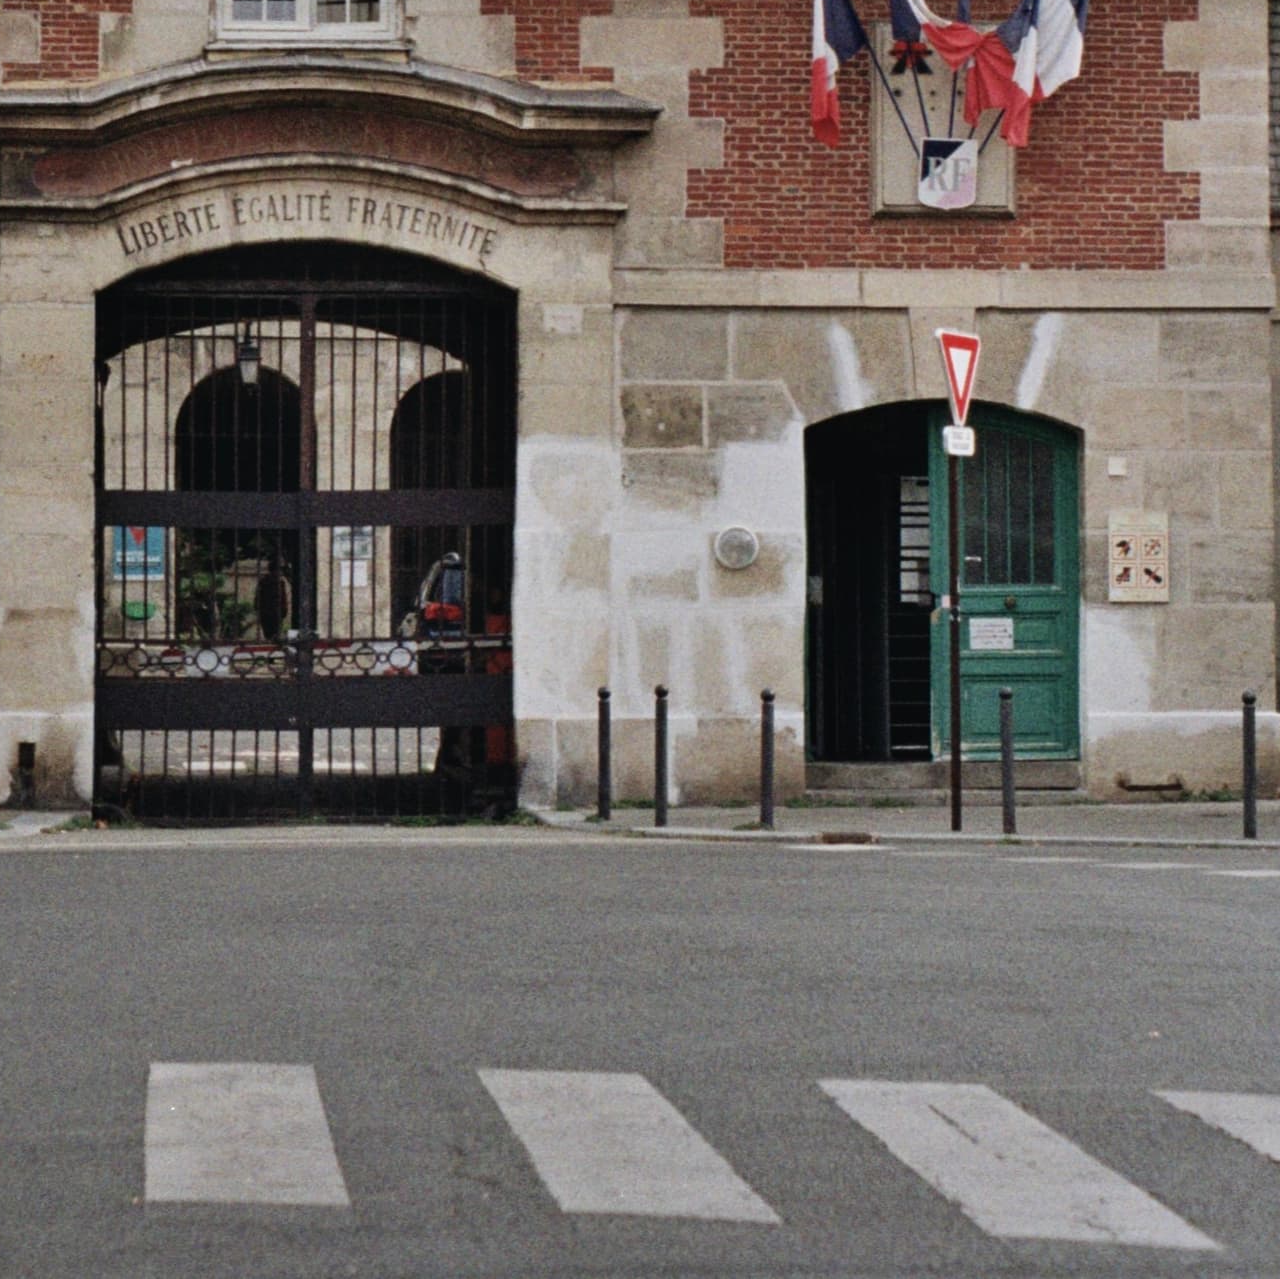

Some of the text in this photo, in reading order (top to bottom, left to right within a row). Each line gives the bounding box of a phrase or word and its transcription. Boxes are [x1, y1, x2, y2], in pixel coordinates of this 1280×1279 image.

[927, 157, 971, 192] RF
[116, 199, 220, 256] LIBERTÉ
[232, 190, 331, 226] ÉGALITÉ
